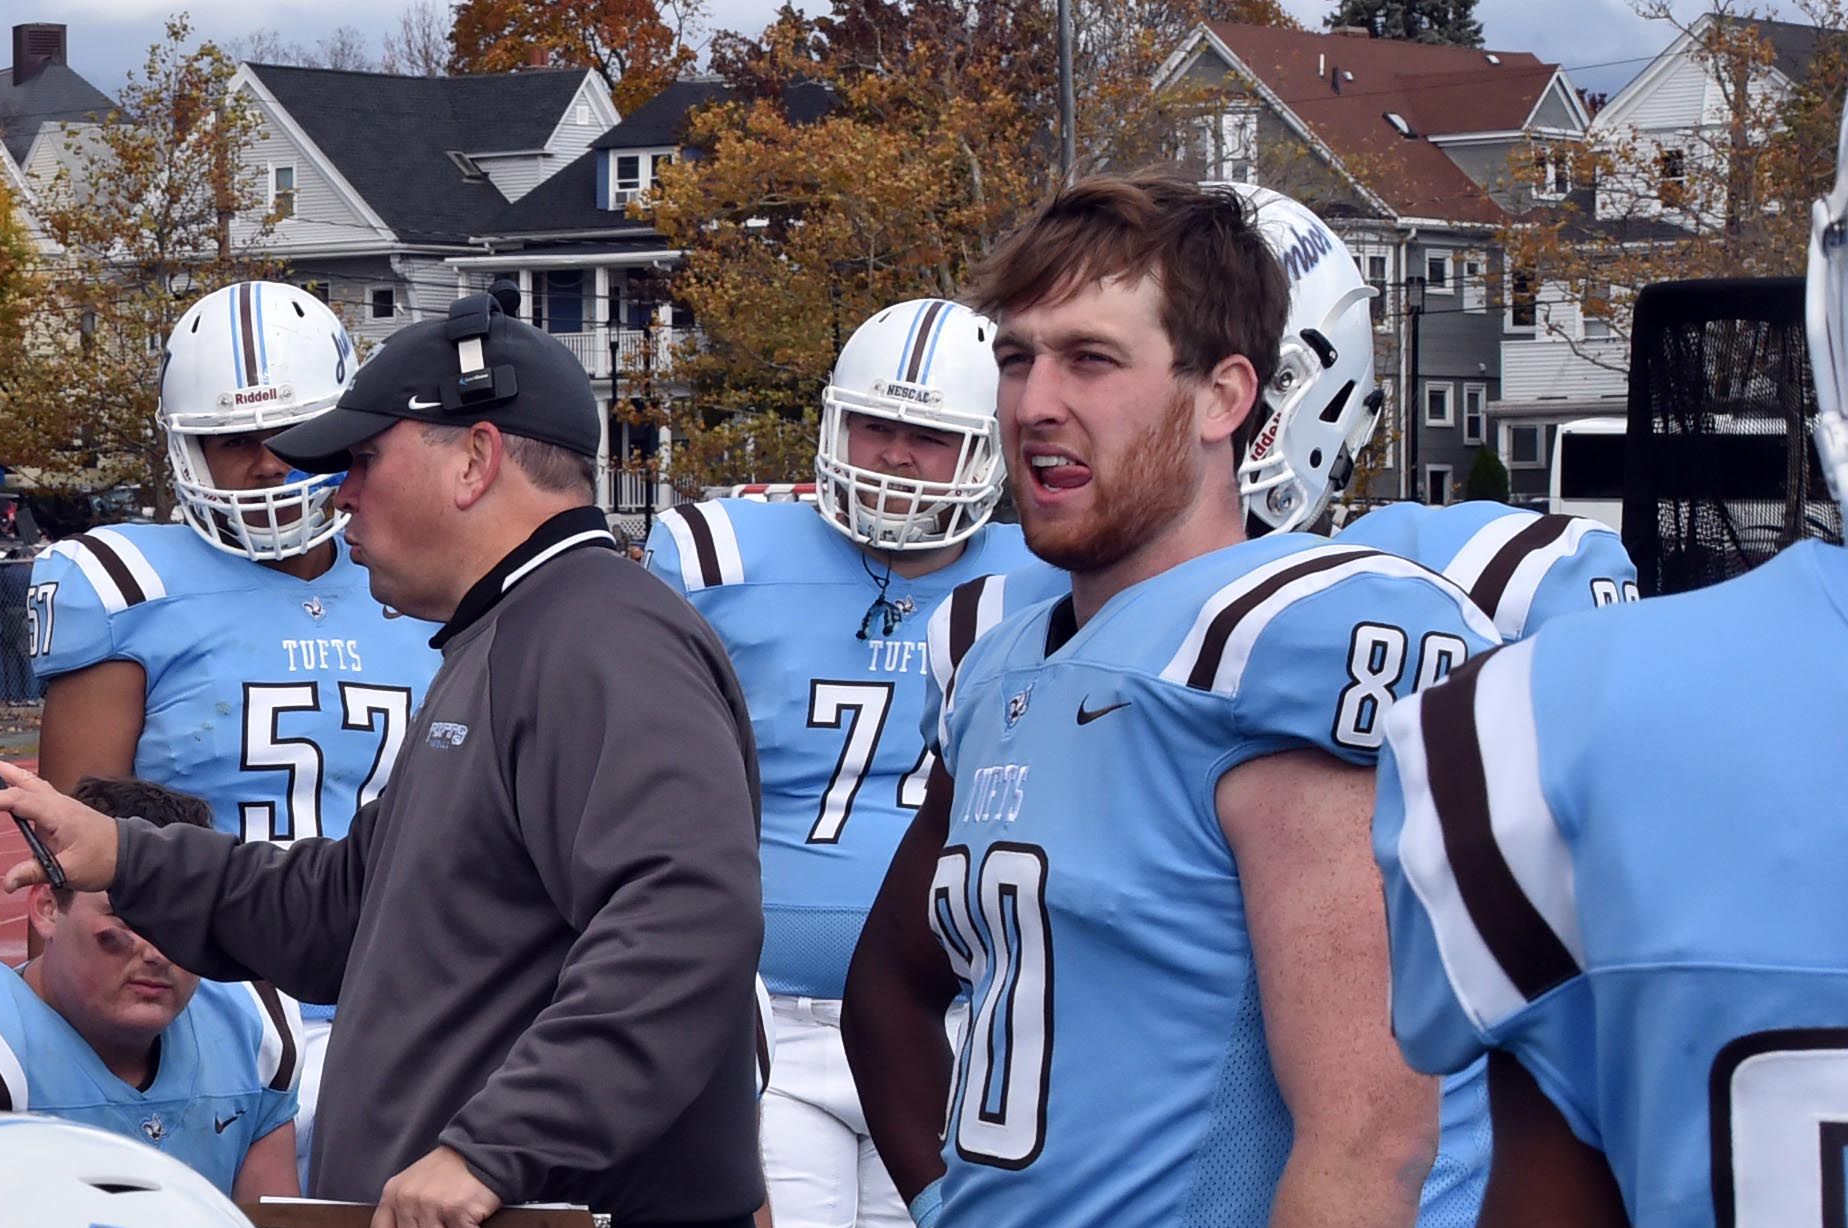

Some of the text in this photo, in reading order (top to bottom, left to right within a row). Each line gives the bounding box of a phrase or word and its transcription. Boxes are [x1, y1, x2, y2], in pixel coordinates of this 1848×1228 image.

[235, 387, 278, 406] Riddell
[887, 384, 929, 404] NESCAC
[27, 581, 59, 658] 57
[282, 639, 363, 672] TUFTS
[868, 640, 929, 676] TUFT
[237, 680, 413, 851] 57
[963, 764, 1031, 823] TUFTS
